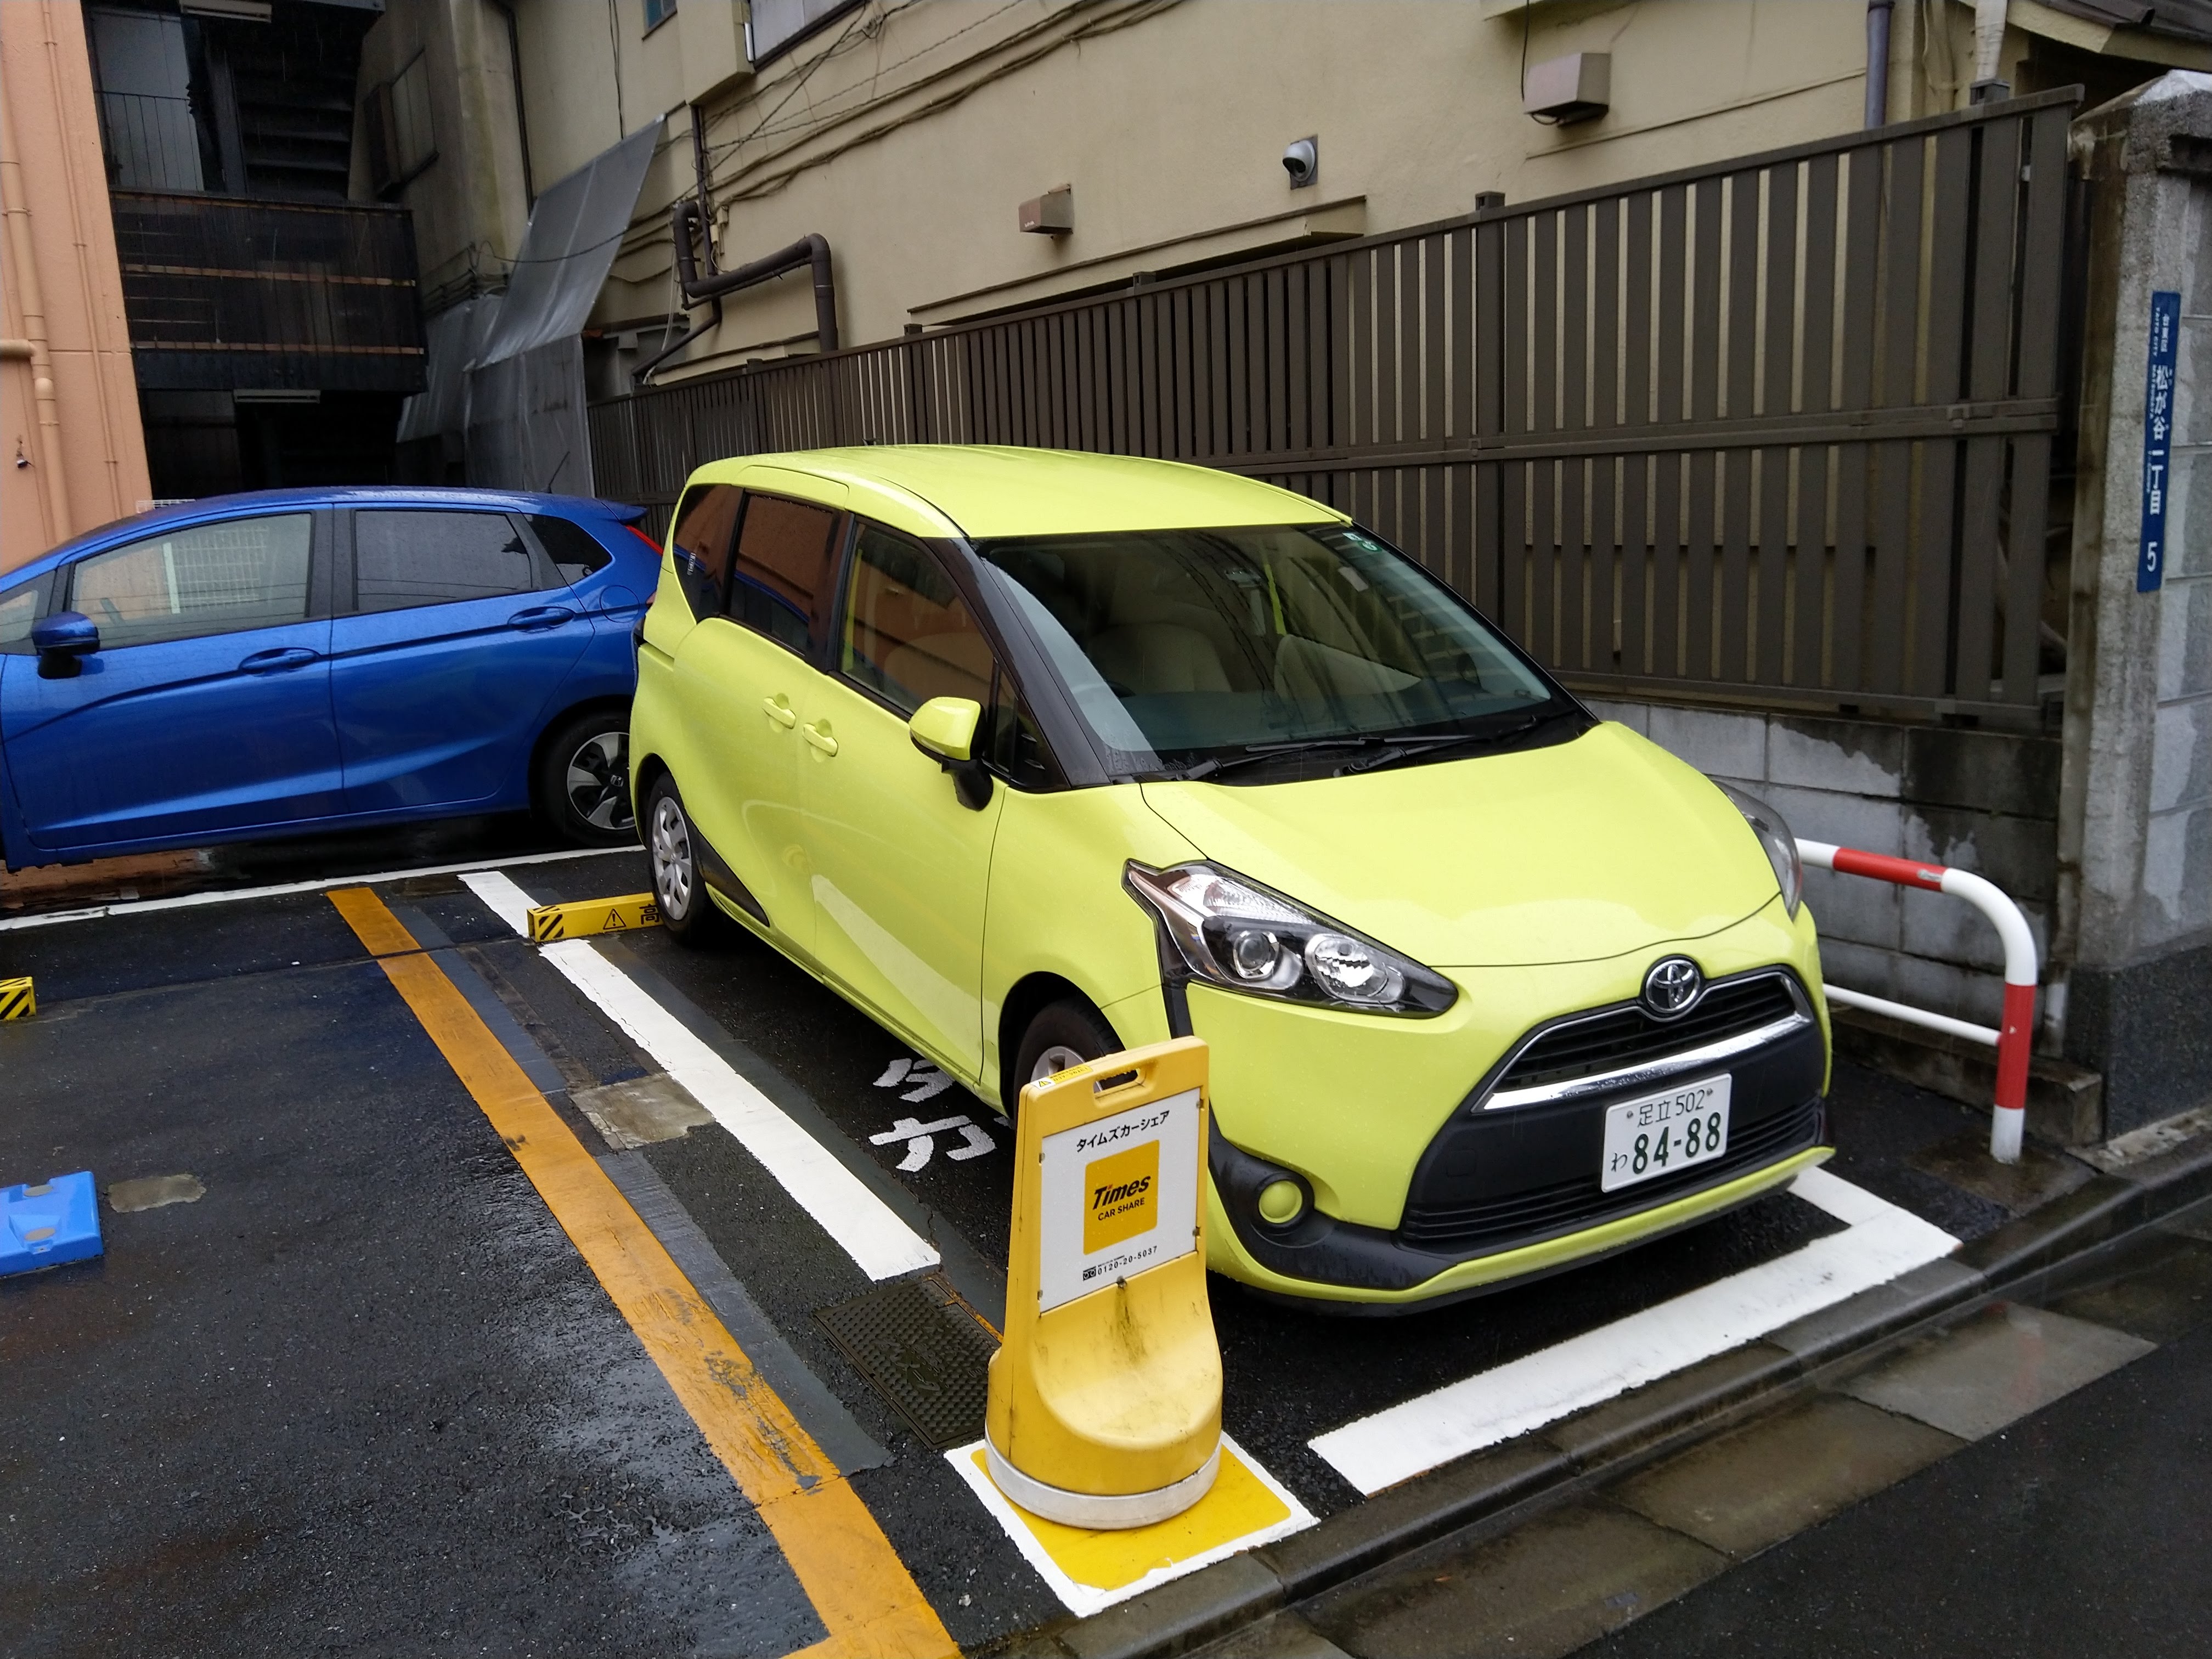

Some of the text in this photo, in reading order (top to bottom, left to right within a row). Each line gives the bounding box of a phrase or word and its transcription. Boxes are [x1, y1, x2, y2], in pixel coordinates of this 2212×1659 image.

[2147, 541, 2158, 572] 5
[639, 903, 659, 926] 高
[1637, 1089, 1705, 1127] 足立 502
[1076, 1110, 1170, 1153] タイムズカーシェア
[1611, 1112, 1721, 1175] わ 84-88
[1092, 1175, 1151, 1210] Times
[1098, 1197, 1146, 1221] CAR SHARE
[1097, 1245, 1158, 1275] 0120-20-5037
